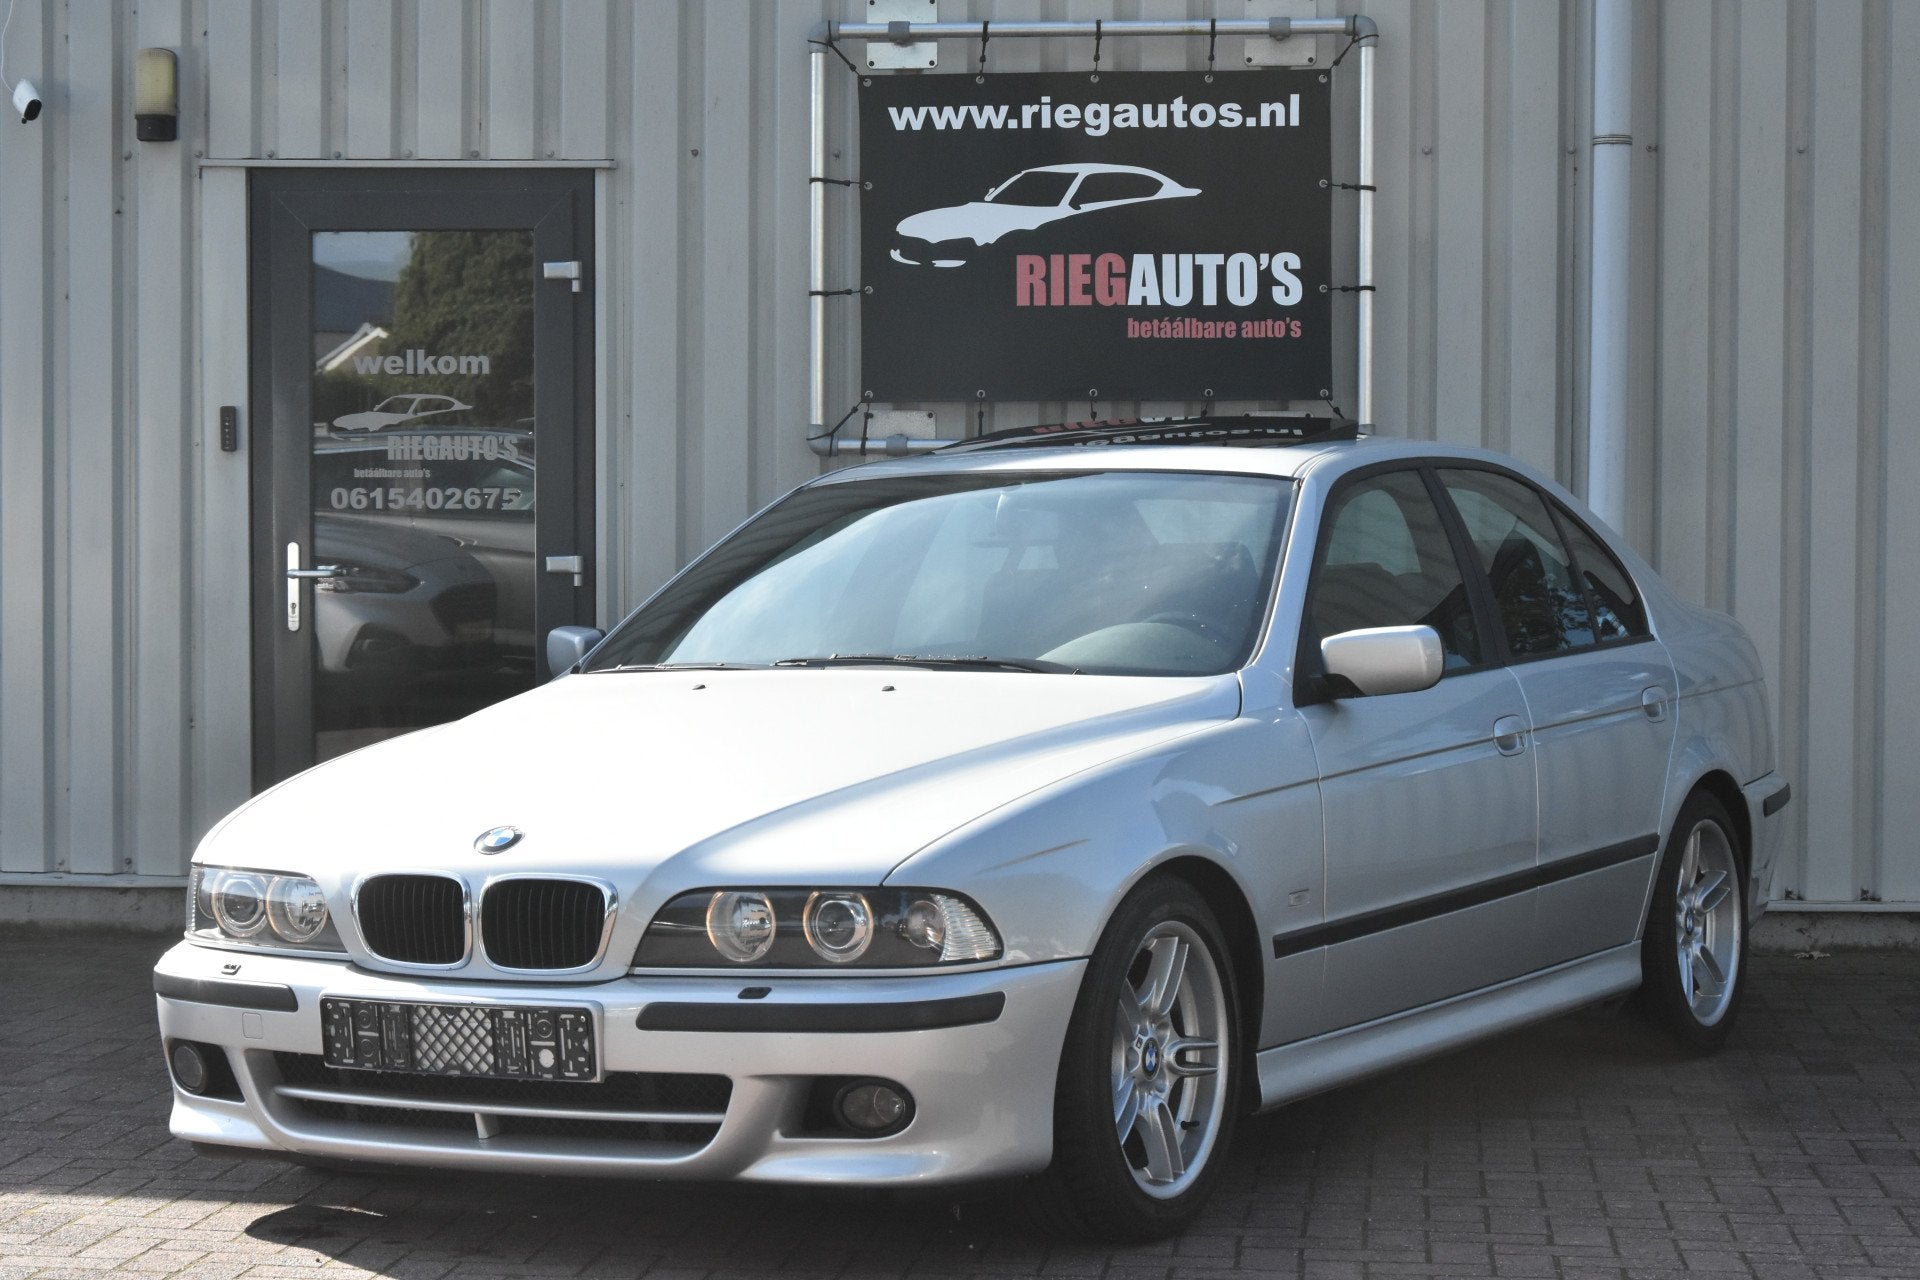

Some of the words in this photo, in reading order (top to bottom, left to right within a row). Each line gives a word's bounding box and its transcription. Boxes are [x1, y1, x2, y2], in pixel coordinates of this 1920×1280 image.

[887, 94, 1301, 137] www.riegautos.nl
[1127, 316, 1237, 339] betáálbare
[353, 349, 490, 375] welkom
[330, 487, 521, 510] 0615402675
